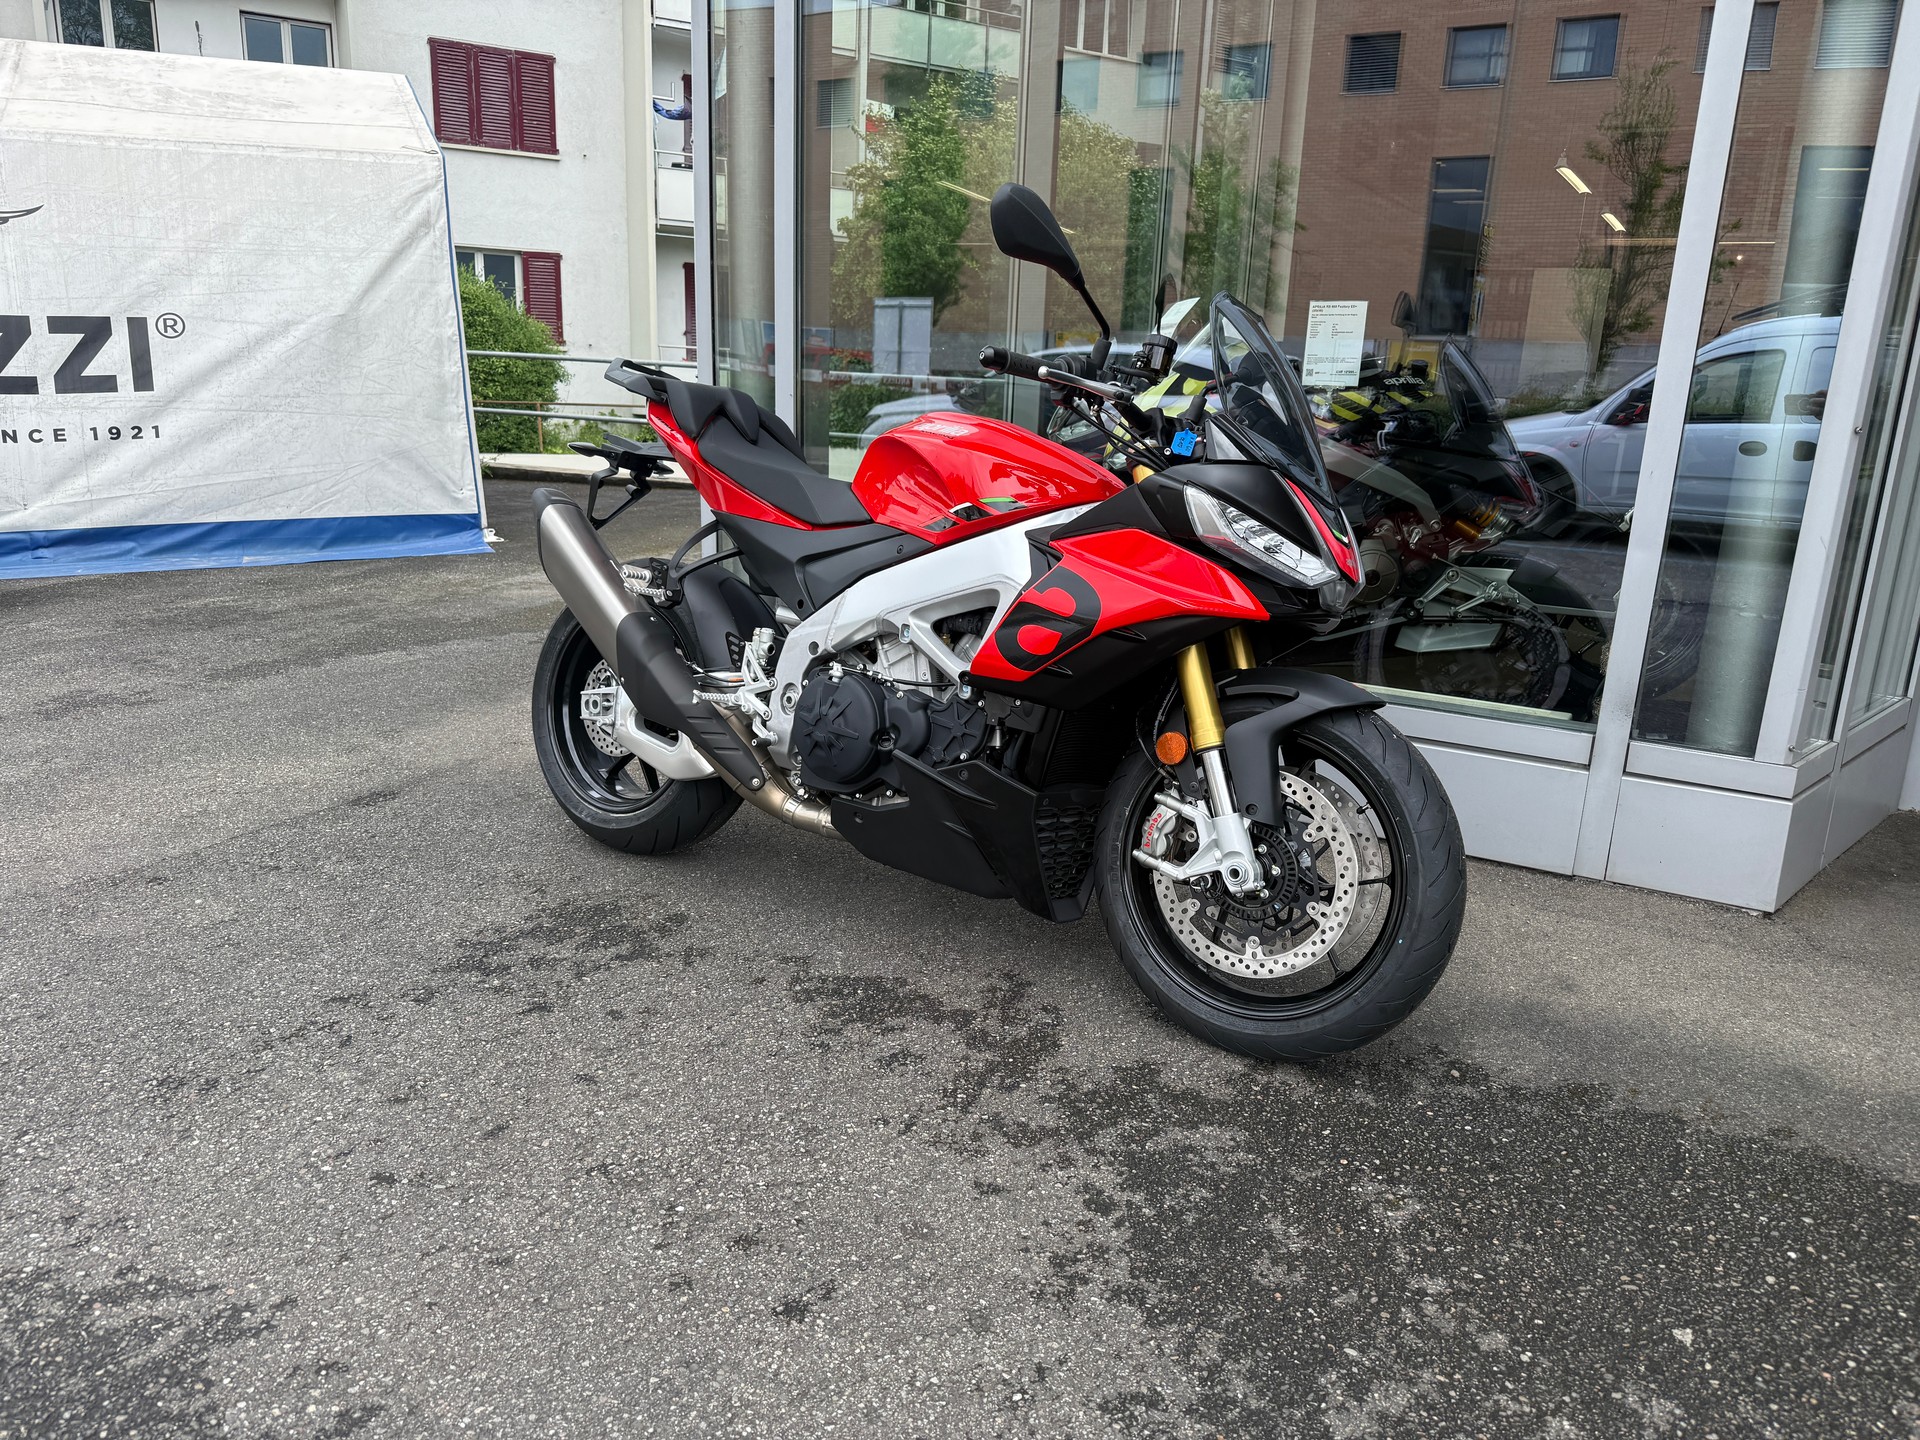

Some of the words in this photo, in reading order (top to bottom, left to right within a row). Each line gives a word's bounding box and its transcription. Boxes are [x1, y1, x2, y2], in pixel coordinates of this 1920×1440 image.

[1383, 375, 1425, 386] aprilia
[0, 428, 68, 444] NCE
[89, 425, 161, 442] 1921
[1143, 812, 1162, 848] brembo
